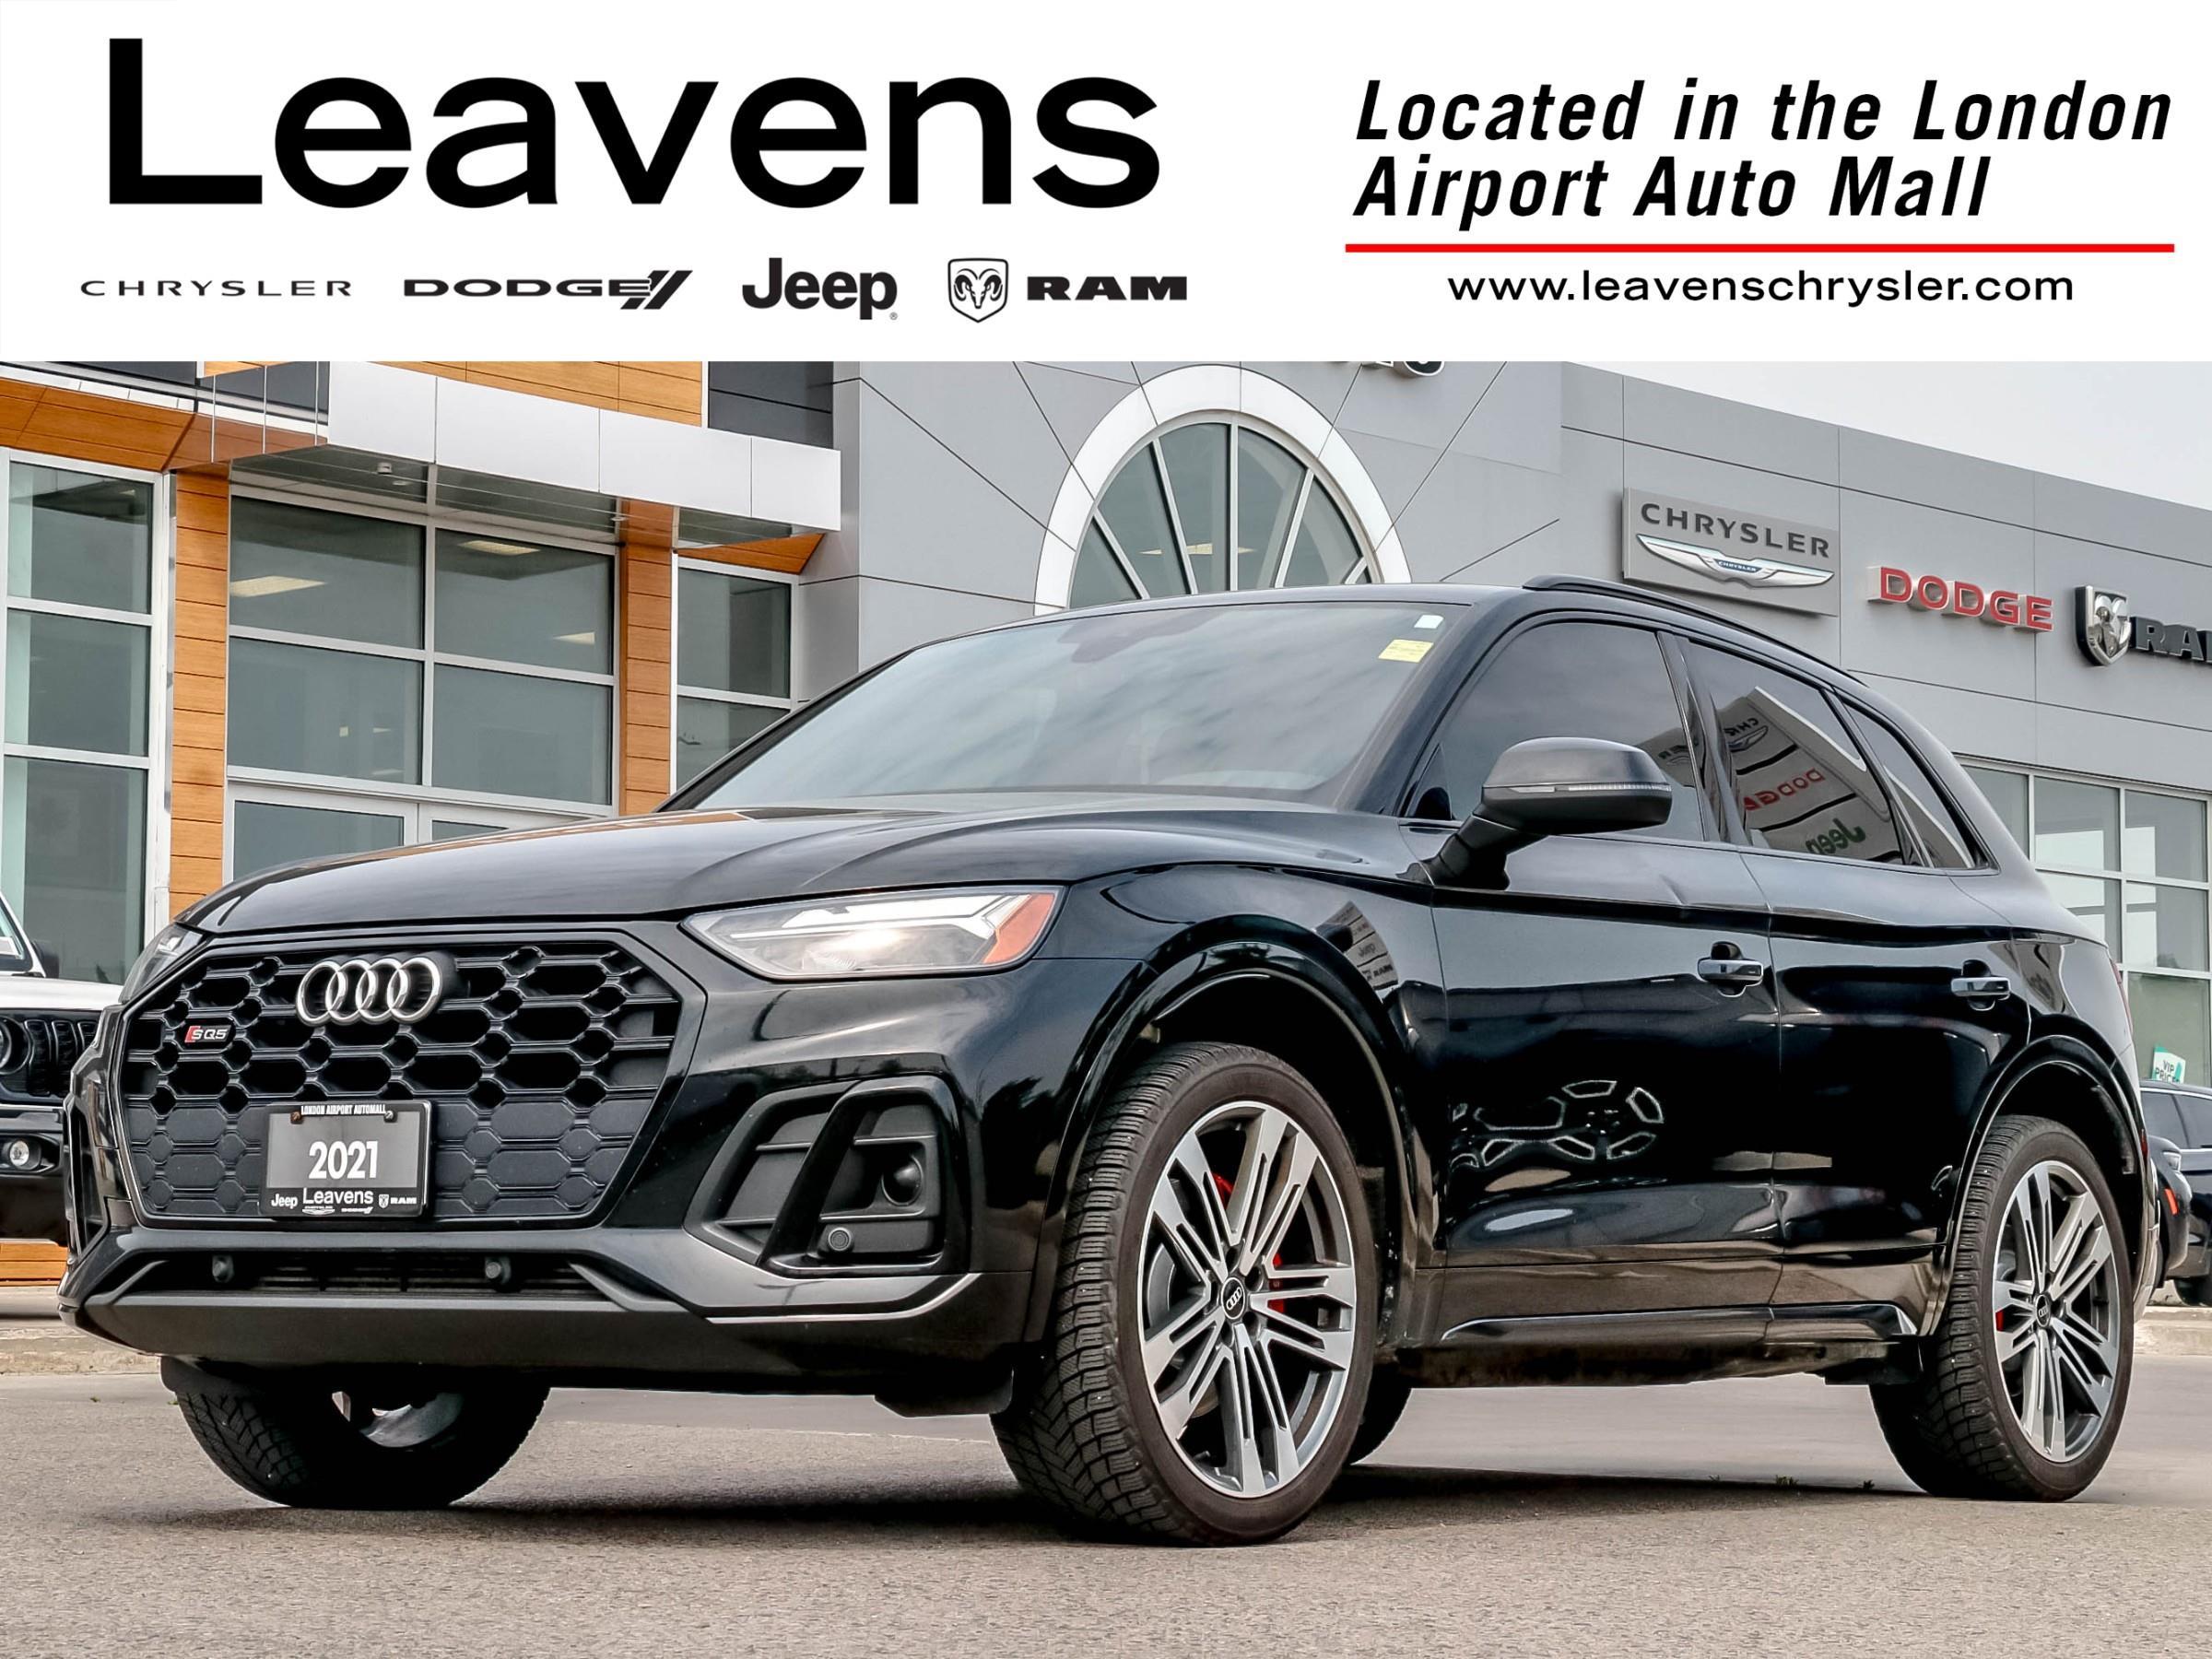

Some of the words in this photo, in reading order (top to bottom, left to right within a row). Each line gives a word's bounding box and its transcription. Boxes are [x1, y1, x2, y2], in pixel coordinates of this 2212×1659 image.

[1641, 503, 1830, 558] CHRYSLER
[1718, 560, 1757, 571] CHRYSLER
[1880, 566, 2053, 631] DODGE
[2132, 616, 2212, 662] RA
[191, 1028, 229, 1041] SQ5
[301, 1105, 325, 1114] LONDON
[326, 1105, 352, 1114] AIRPORT
[354, 1104, 386, 1114] AUTOMALL
[309, 1141, 378, 1179] 2021
[271, 1194, 298, 1209] Jeep
[303, 1187, 373, 1204] Leavens
